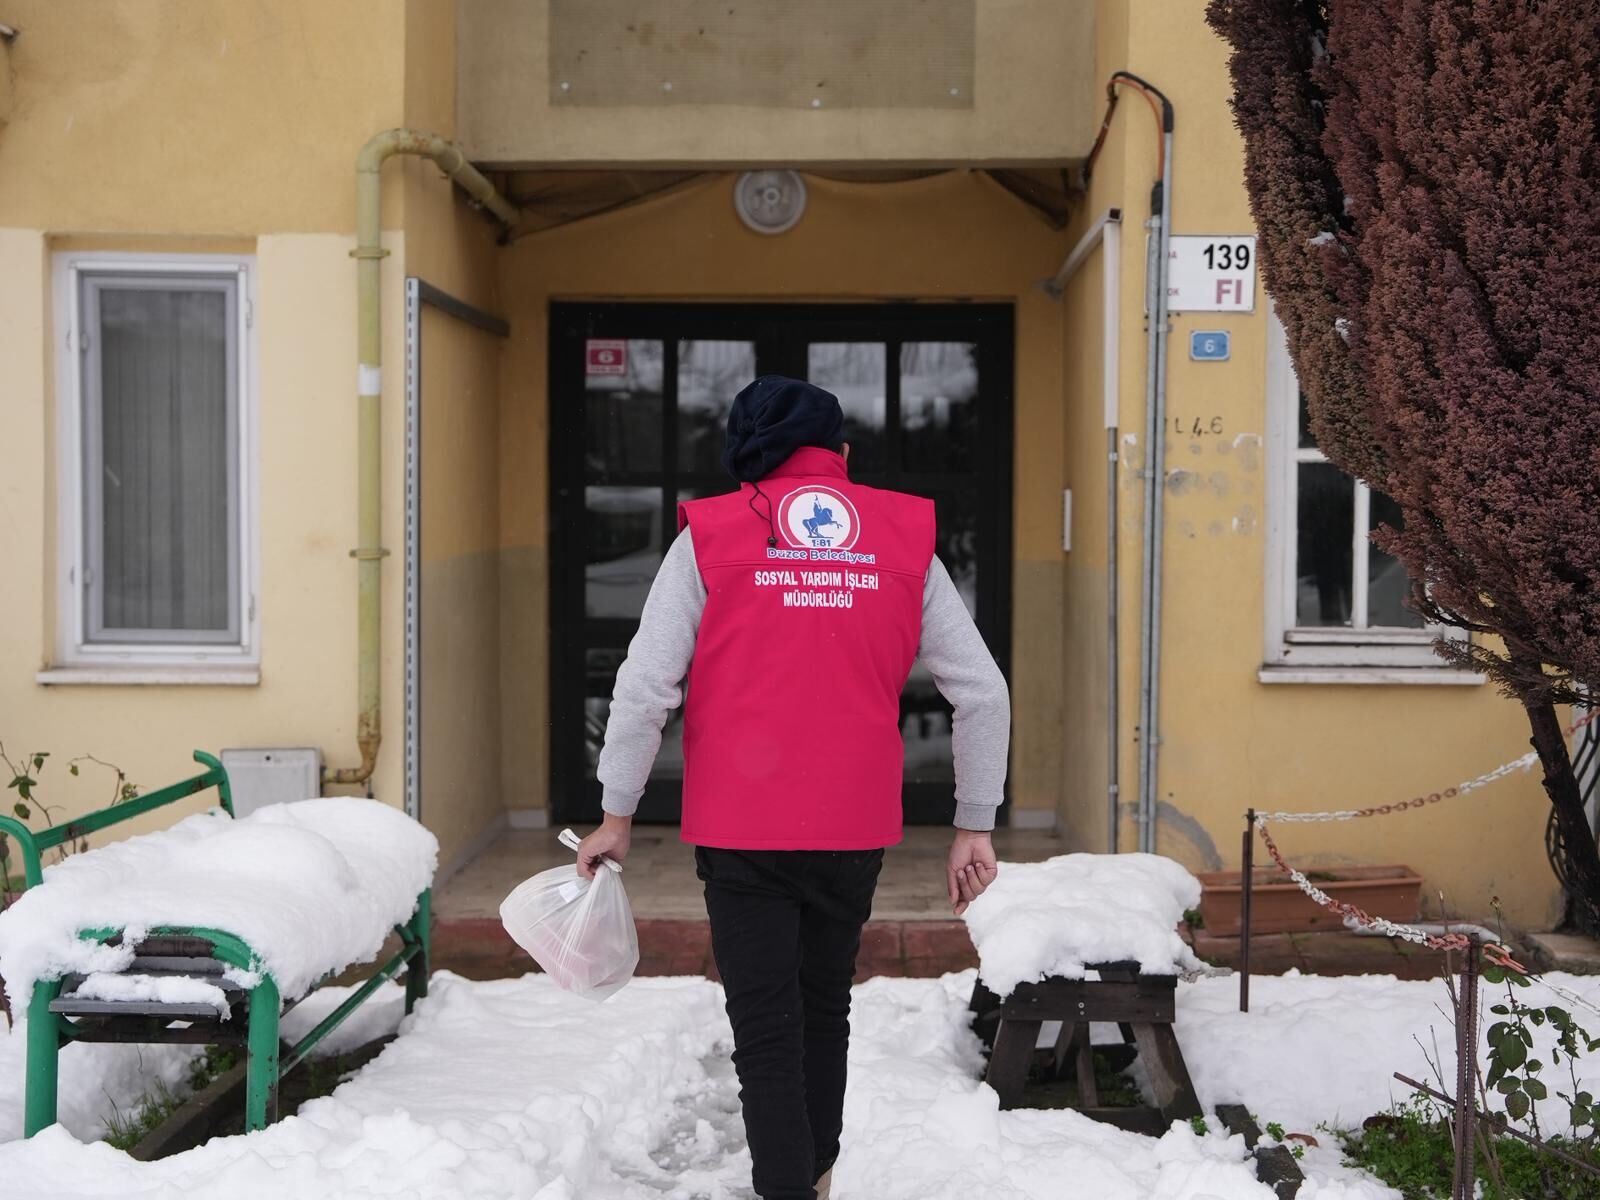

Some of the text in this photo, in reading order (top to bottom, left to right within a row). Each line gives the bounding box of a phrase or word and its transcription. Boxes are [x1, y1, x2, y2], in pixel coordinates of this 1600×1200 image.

[1203, 244, 1250, 270] 139
[1205, 340, 1215, 353] 6
[598, 350, 614, 364] 6
[767, 548, 876, 564] Düzce Belediyesi
[754, 569, 879, 590] SOSYAL YARDIM İŞLERİ
[783, 590, 853, 608] MÜDÜRLÜĞÜ
